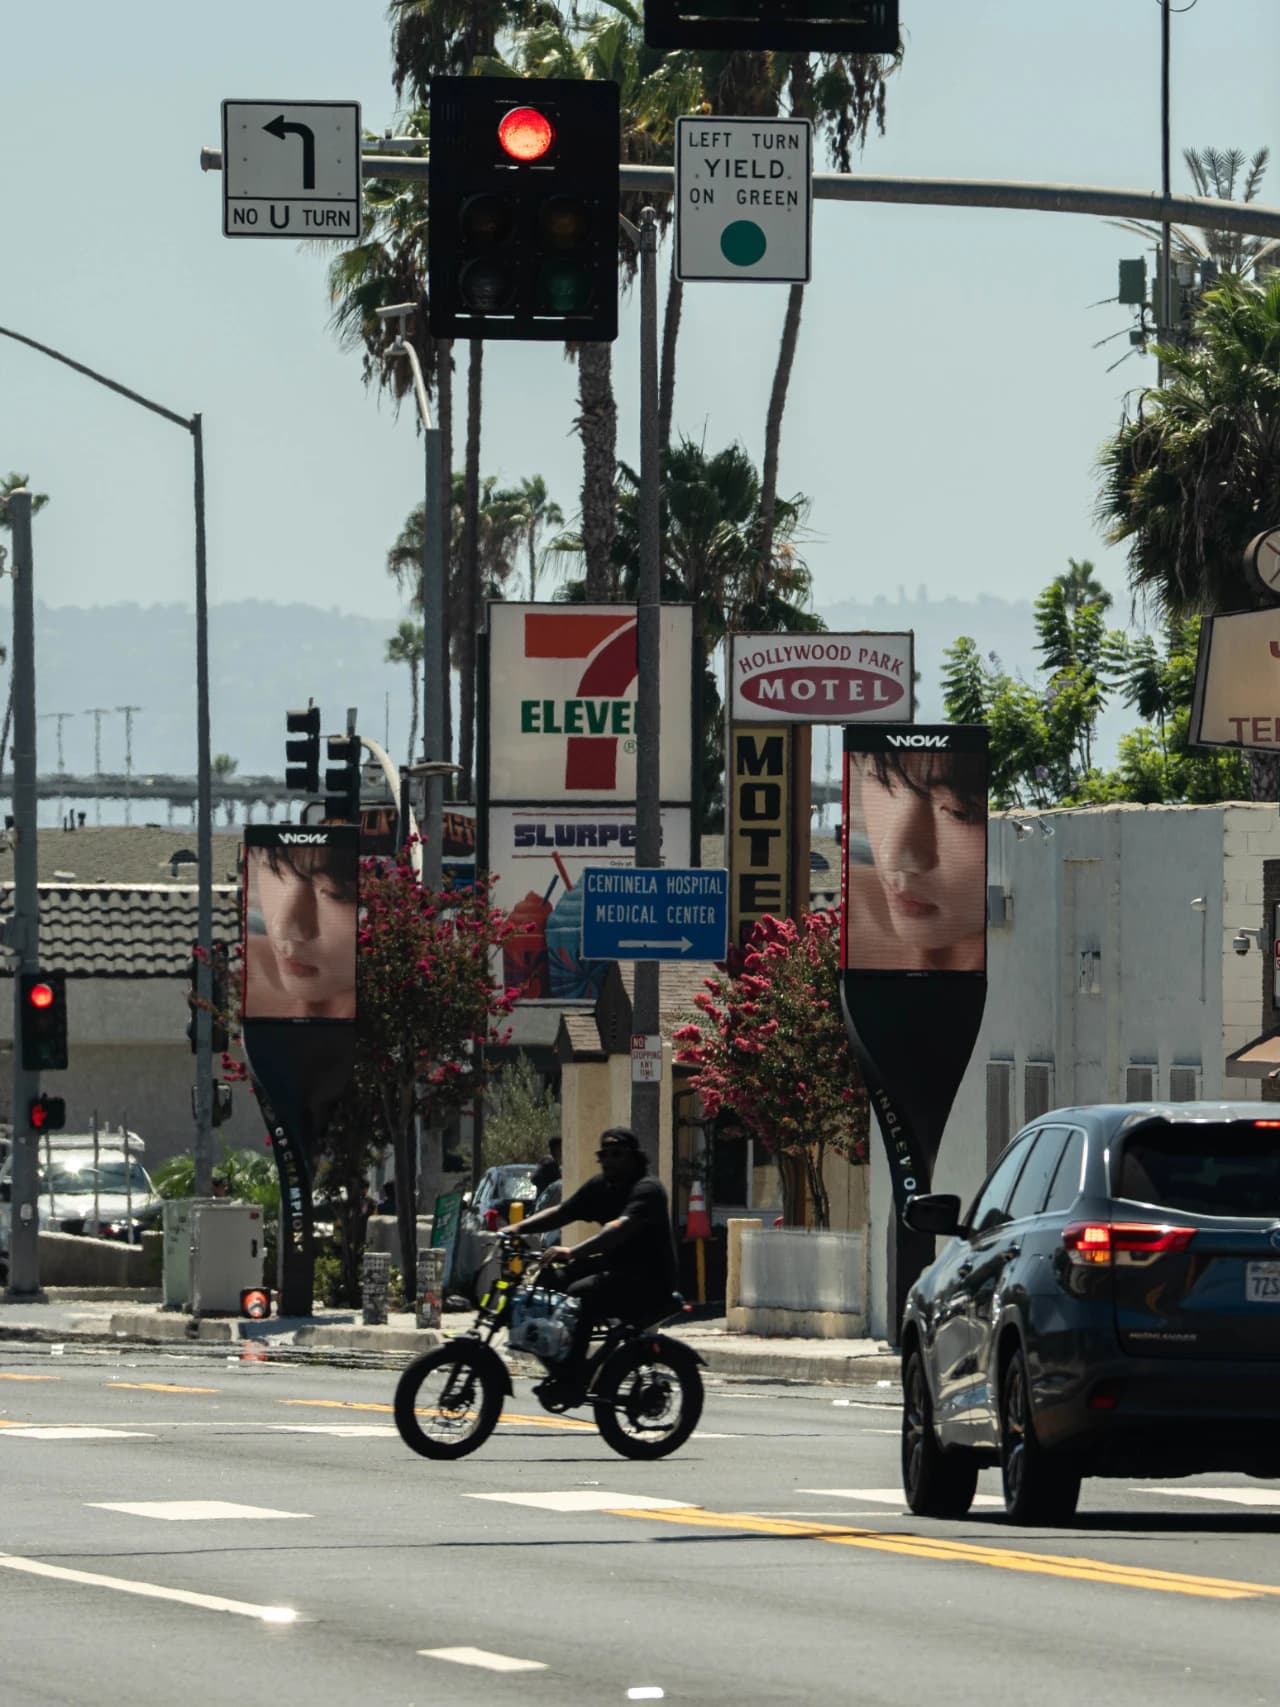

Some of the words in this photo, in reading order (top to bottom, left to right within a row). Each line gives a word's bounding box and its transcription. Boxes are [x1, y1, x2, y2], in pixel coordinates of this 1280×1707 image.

[689, 132, 732, 148] LEFT
[752, 133, 799, 149] TURN
[704, 159, 784, 179] YIELD
[689, 188, 714, 204] ON
[736, 189, 798, 205] GREEN
[233, 207, 258, 225] NO
[270, 204, 289, 229] U
[303, 209, 350, 227] TURN
[739, 643, 851, 674] HOLLYWOOD
[858, 647, 905, 677] PARK
[758, 678, 889, 701] MOTEL
[521, 699, 637, 735] ELEVE
[514, 824, 663, 848] SLURPE
[587, 873, 658, 895] CENTINELA
[666, 874, 724, 895] HOSPITAL
[596, 904, 657, 924] MEDICAL
[666, 905, 716, 925] CENTER
[633, 1037, 646, 1049] NO
